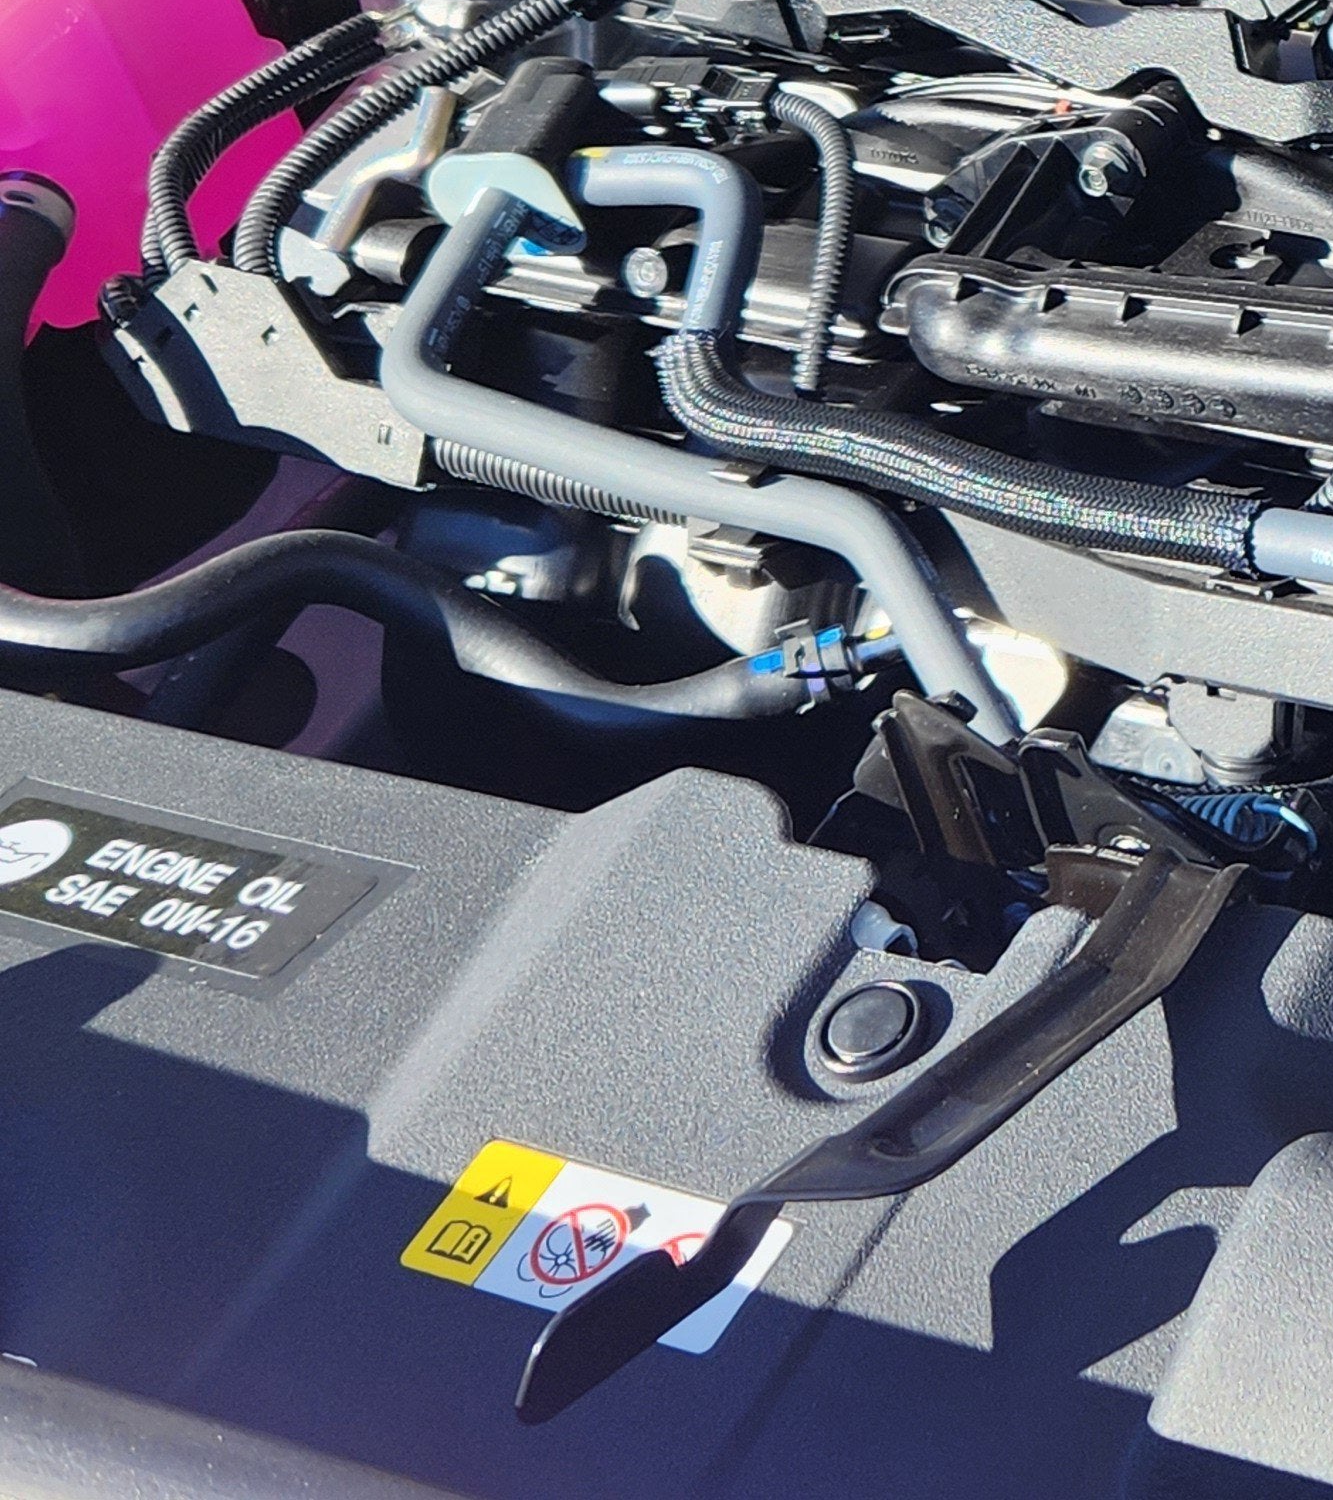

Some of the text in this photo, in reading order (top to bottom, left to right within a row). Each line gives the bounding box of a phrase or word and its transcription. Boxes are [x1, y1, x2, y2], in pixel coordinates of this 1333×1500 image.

[45, 873, 270, 950] SAE 0W-16
[85, 838, 306, 915] ENGINE OIL
